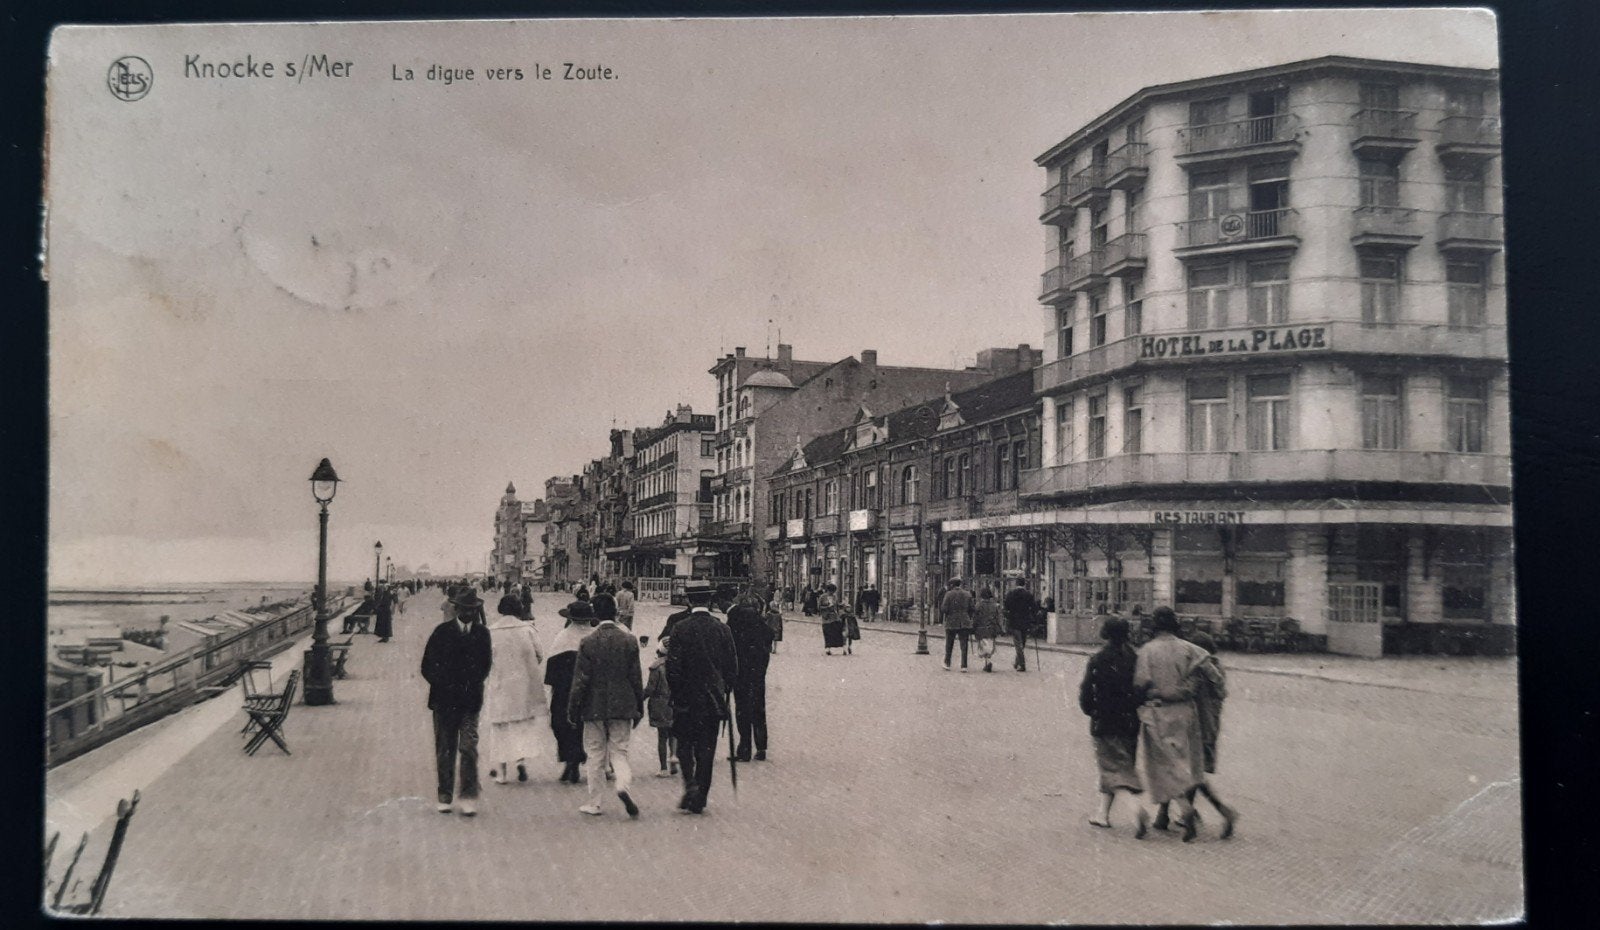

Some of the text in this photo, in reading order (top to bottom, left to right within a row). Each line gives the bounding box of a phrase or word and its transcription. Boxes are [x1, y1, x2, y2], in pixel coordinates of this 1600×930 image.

[1141, 327, 1326, 358] HOTEL DE LA PLAGE
